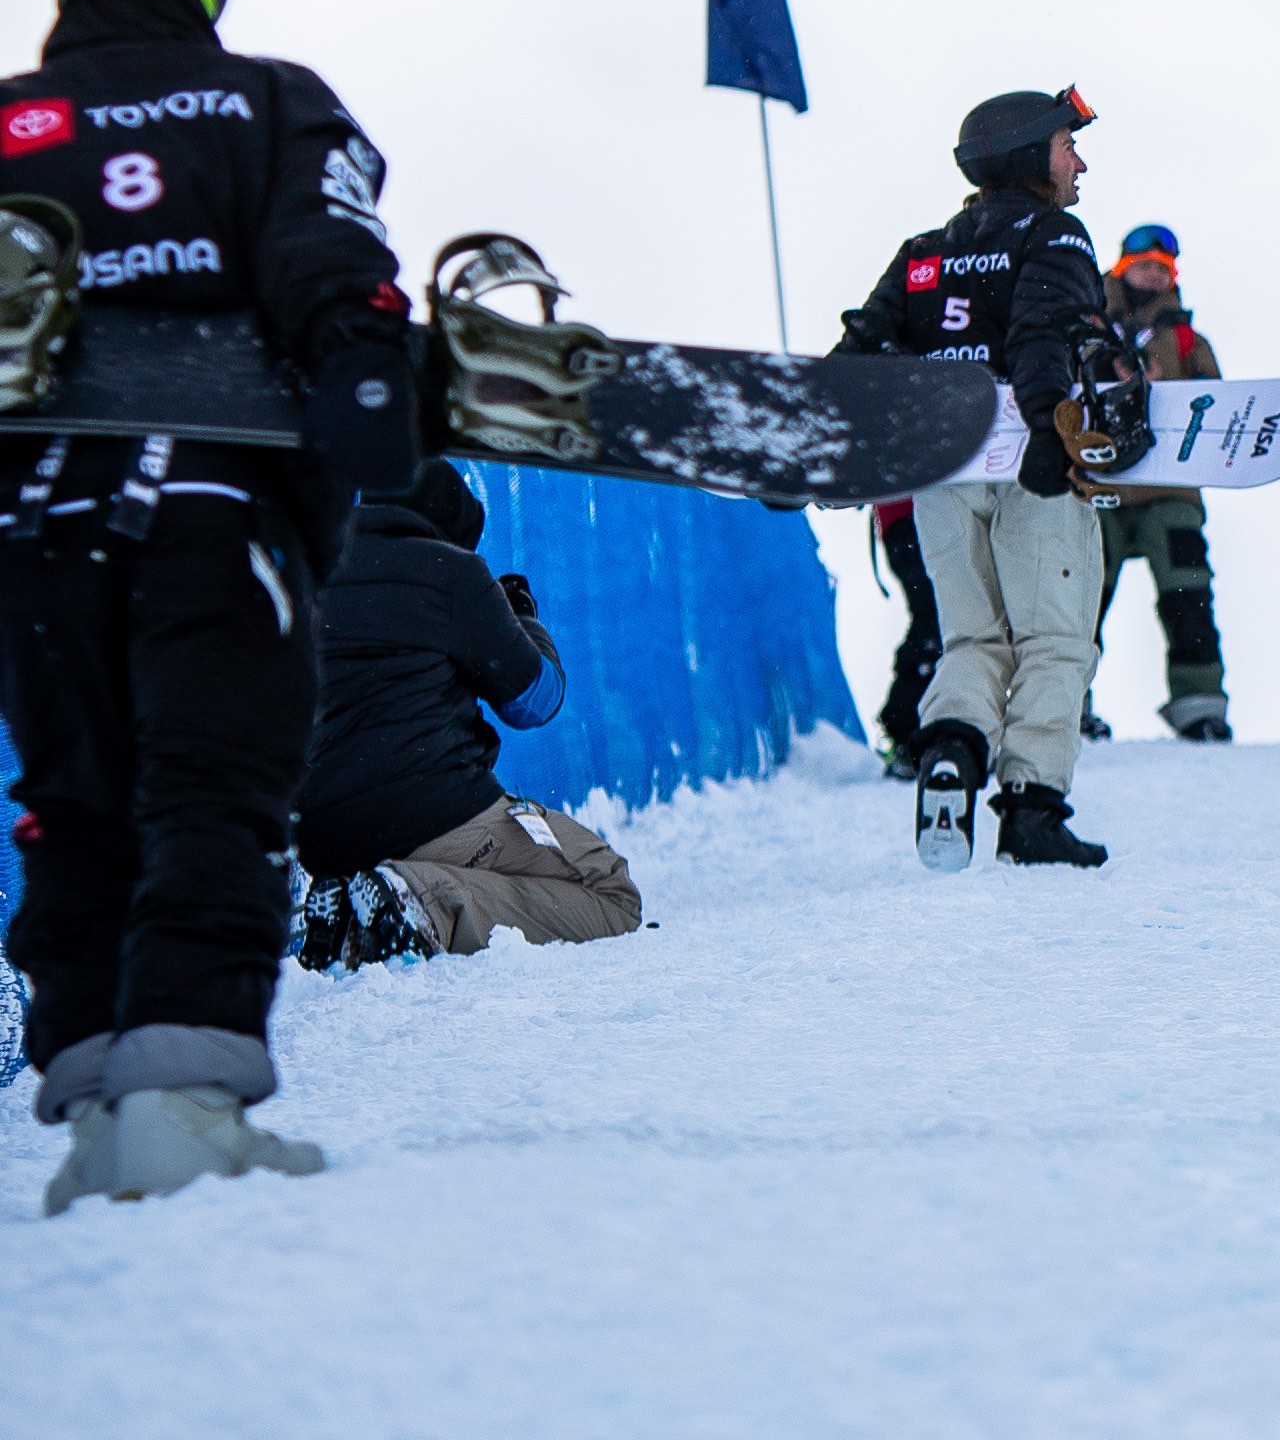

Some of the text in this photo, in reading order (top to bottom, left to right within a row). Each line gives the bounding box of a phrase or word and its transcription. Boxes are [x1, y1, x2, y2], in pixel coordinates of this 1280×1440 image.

[84, 89, 254, 129] TOYOTA
[101, 150, 165, 213] 8
[942, 252, 1011, 275] TOYOTA
[941, 296, 972, 331] 5
